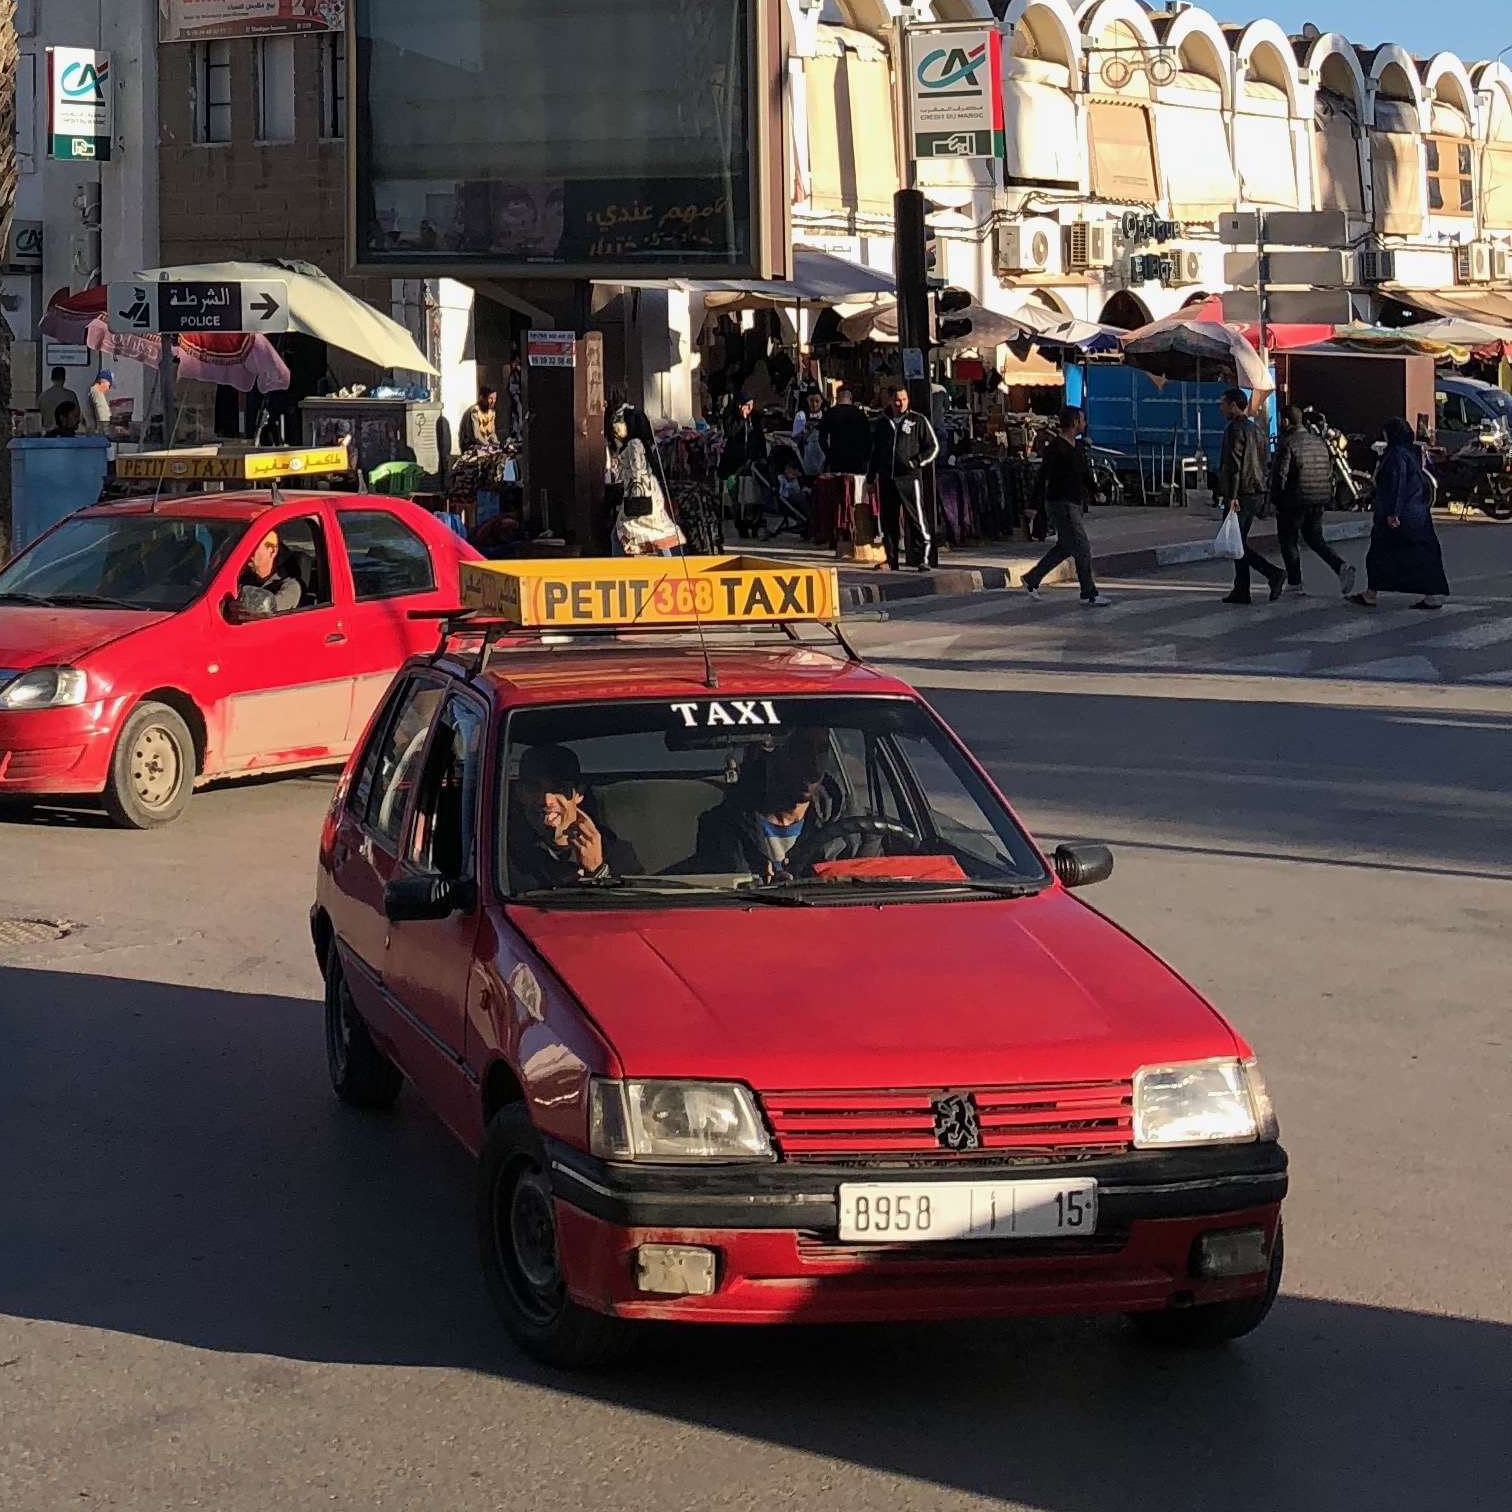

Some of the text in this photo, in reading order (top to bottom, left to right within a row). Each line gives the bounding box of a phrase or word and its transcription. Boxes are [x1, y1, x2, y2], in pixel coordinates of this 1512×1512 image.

[169, 287, 231, 313] الشرطة
[180, 315, 221, 327] POLICE
[123, 458, 166, 476] PETIT
[190, 458, 238, 477] TAXI
[544, 579, 649, 620] PETIT
[720, 575, 815, 617] TAXI
[670, 701, 781, 727] TAXI
[855, 1194, 932, 1232] 8958
[1054, 1190, 1084, 1228] 15
